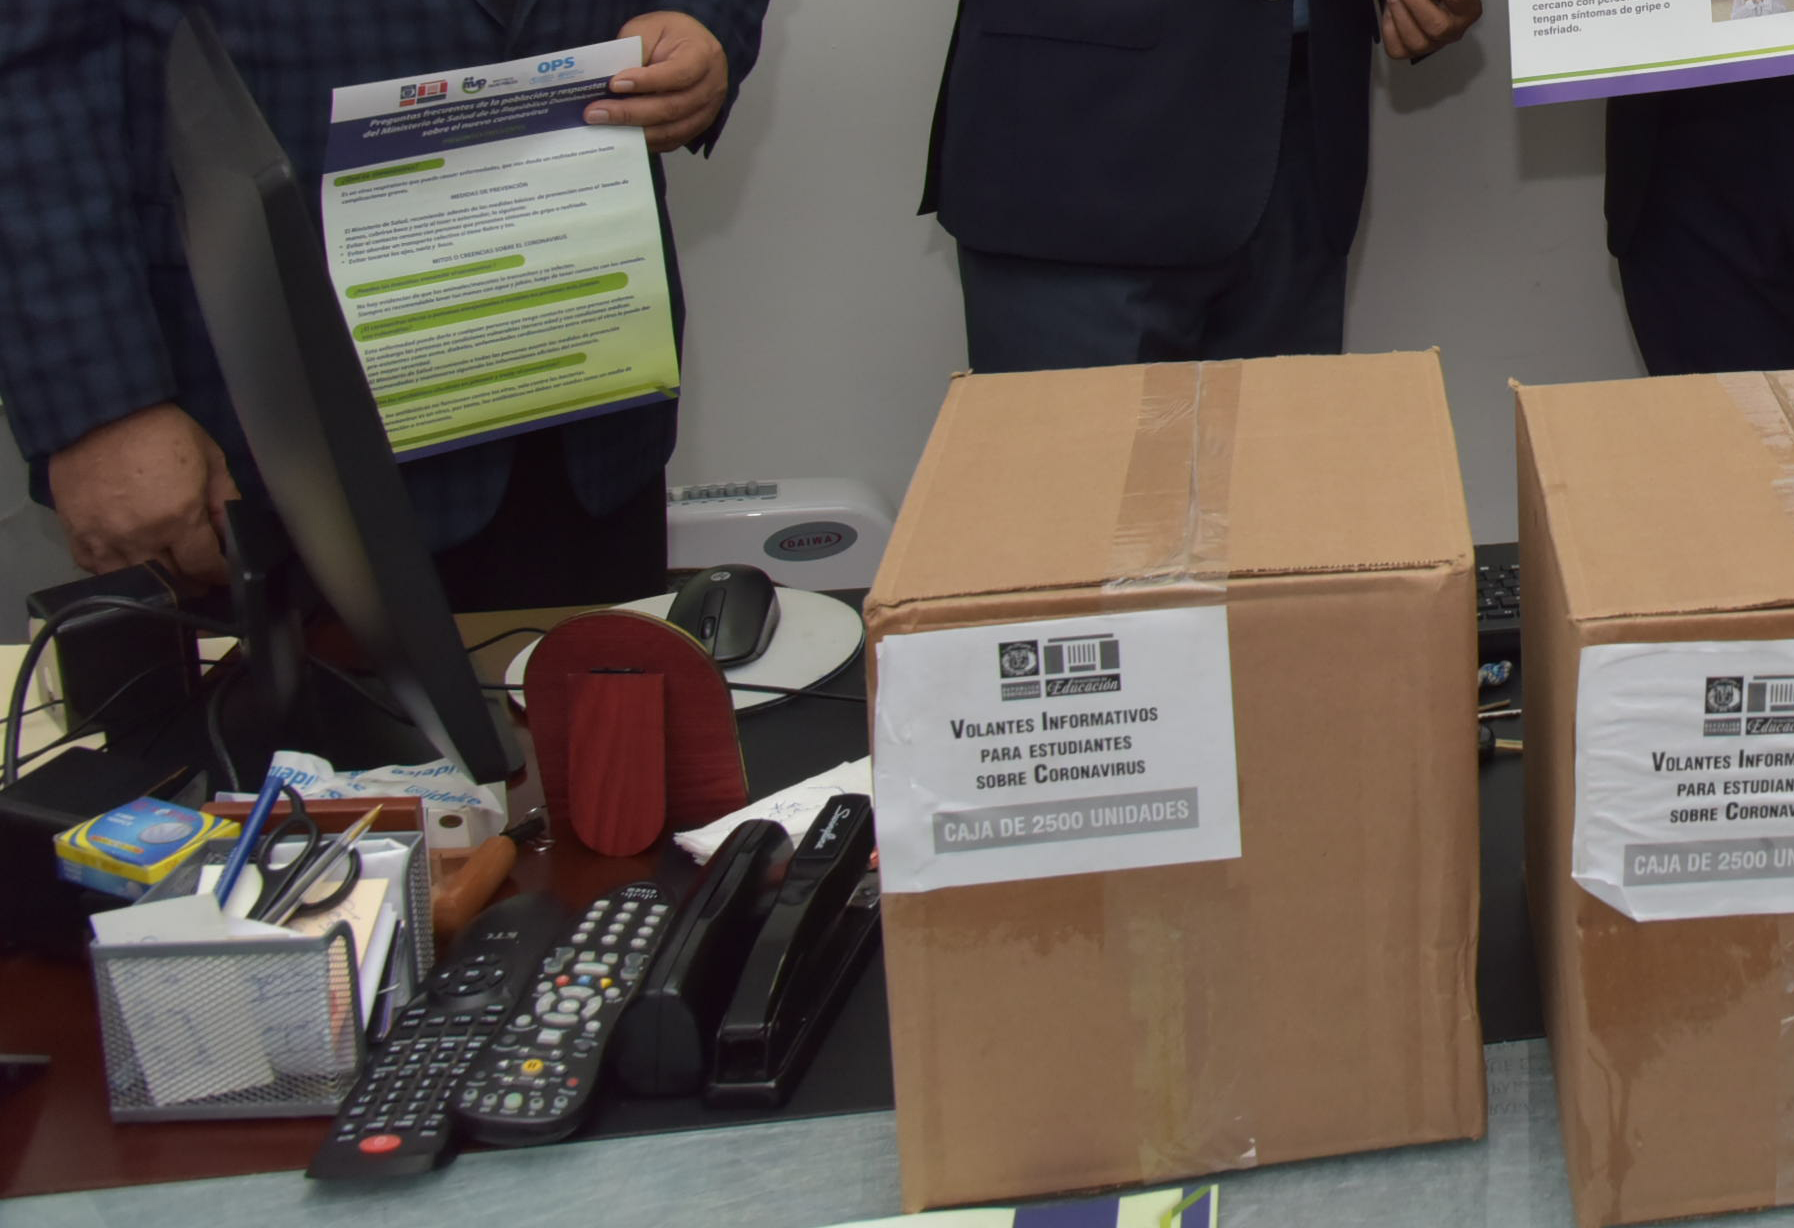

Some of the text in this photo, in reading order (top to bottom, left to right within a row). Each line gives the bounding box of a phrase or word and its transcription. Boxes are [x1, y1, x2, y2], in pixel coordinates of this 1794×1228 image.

[538, 57, 575, 73] OPS
[788, 535, 832, 548] DAIWA
[950, 706, 1159, 740] VOLANTES INFORMATIVOS
[980, 735, 1133, 763] PARA ESTUDIANTES
[1652, 751, 1731, 773] VOLANTES
[976, 760, 1146, 790] SOBRE CORONAVIRUS
[1677, 782, 1716, 797] PARA
[944, 800, 1190, 842] CAJA DE 2500 UNIDADES
[1670, 807, 1718, 823] SOBRE
[1634, 854, 1681, 876] CAJA
[1687, 853, 1712, 871] DE
[1718, 850, 1767, 869] 2500
